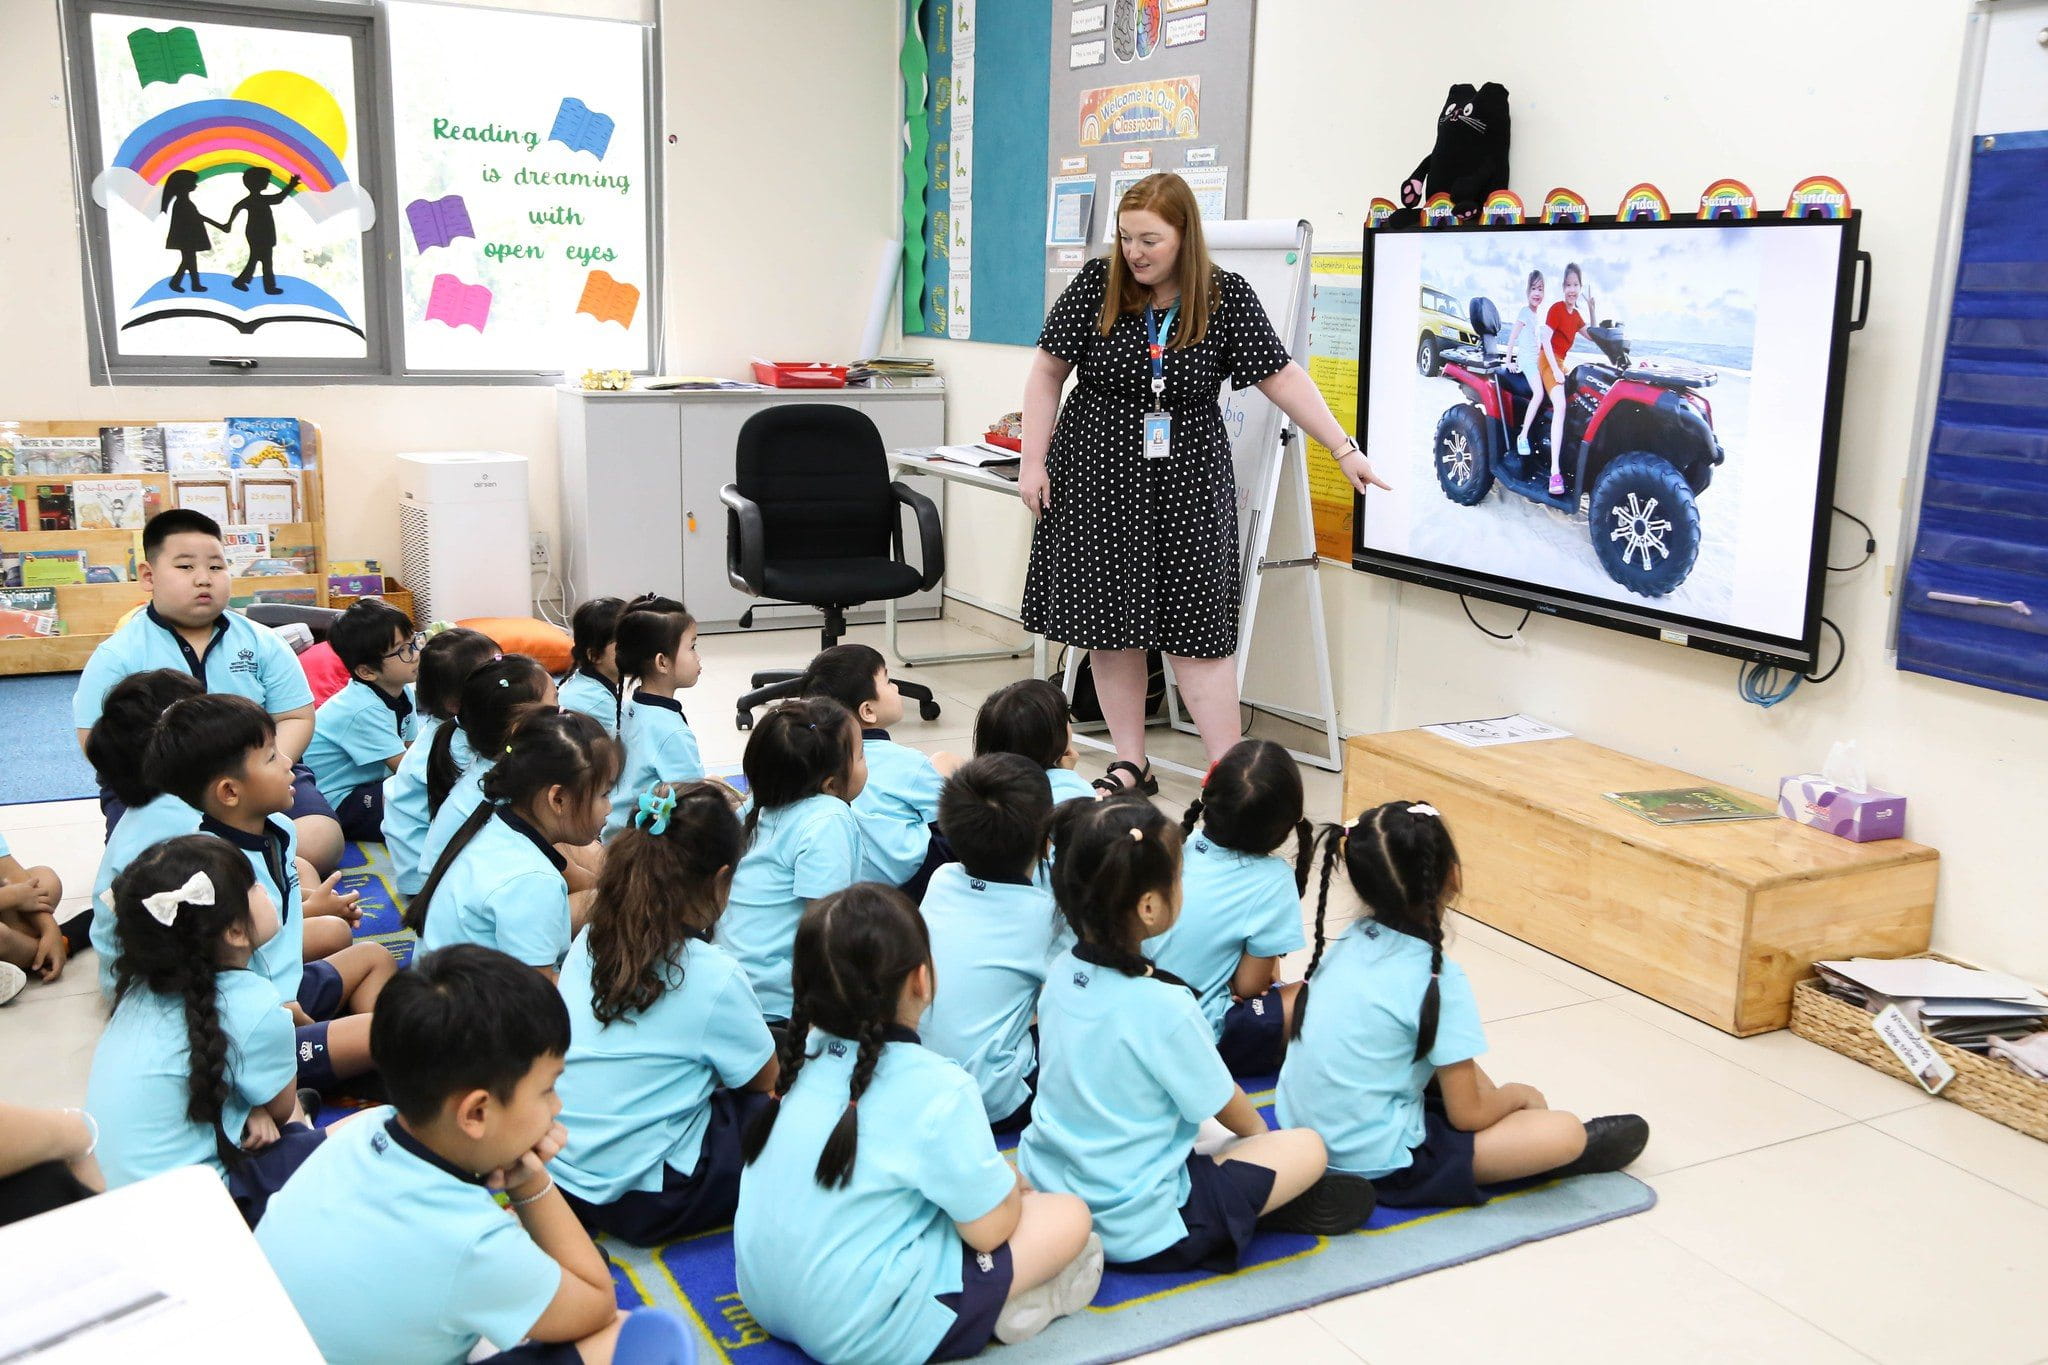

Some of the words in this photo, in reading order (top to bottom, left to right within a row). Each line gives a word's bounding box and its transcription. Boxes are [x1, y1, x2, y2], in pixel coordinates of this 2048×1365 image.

[1101, 90, 1141, 120] Welcome
[1144, 88, 1153, 102] to
[1157, 89, 1175, 112] Our
[1114, 112, 1163, 134] Classroom!
[433, 117, 541, 152] Reading
[482, 163, 502, 183] is
[514, 167, 631, 195] dreaming
[1545, 203, 1586, 216] Thursday
[1626, 197, 1661, 212] Friday
[1701, 195, 1754, 209] Saturday
[1792, 190, 1846, 208] Sunday
[528, 205, 585, 226] with
[1483, 205, 1522, 216] Wednesday
[483, 242, 545, 263] open
[565, 245, 619, 267] eyes
[1224, 396, 1244, 437] big
